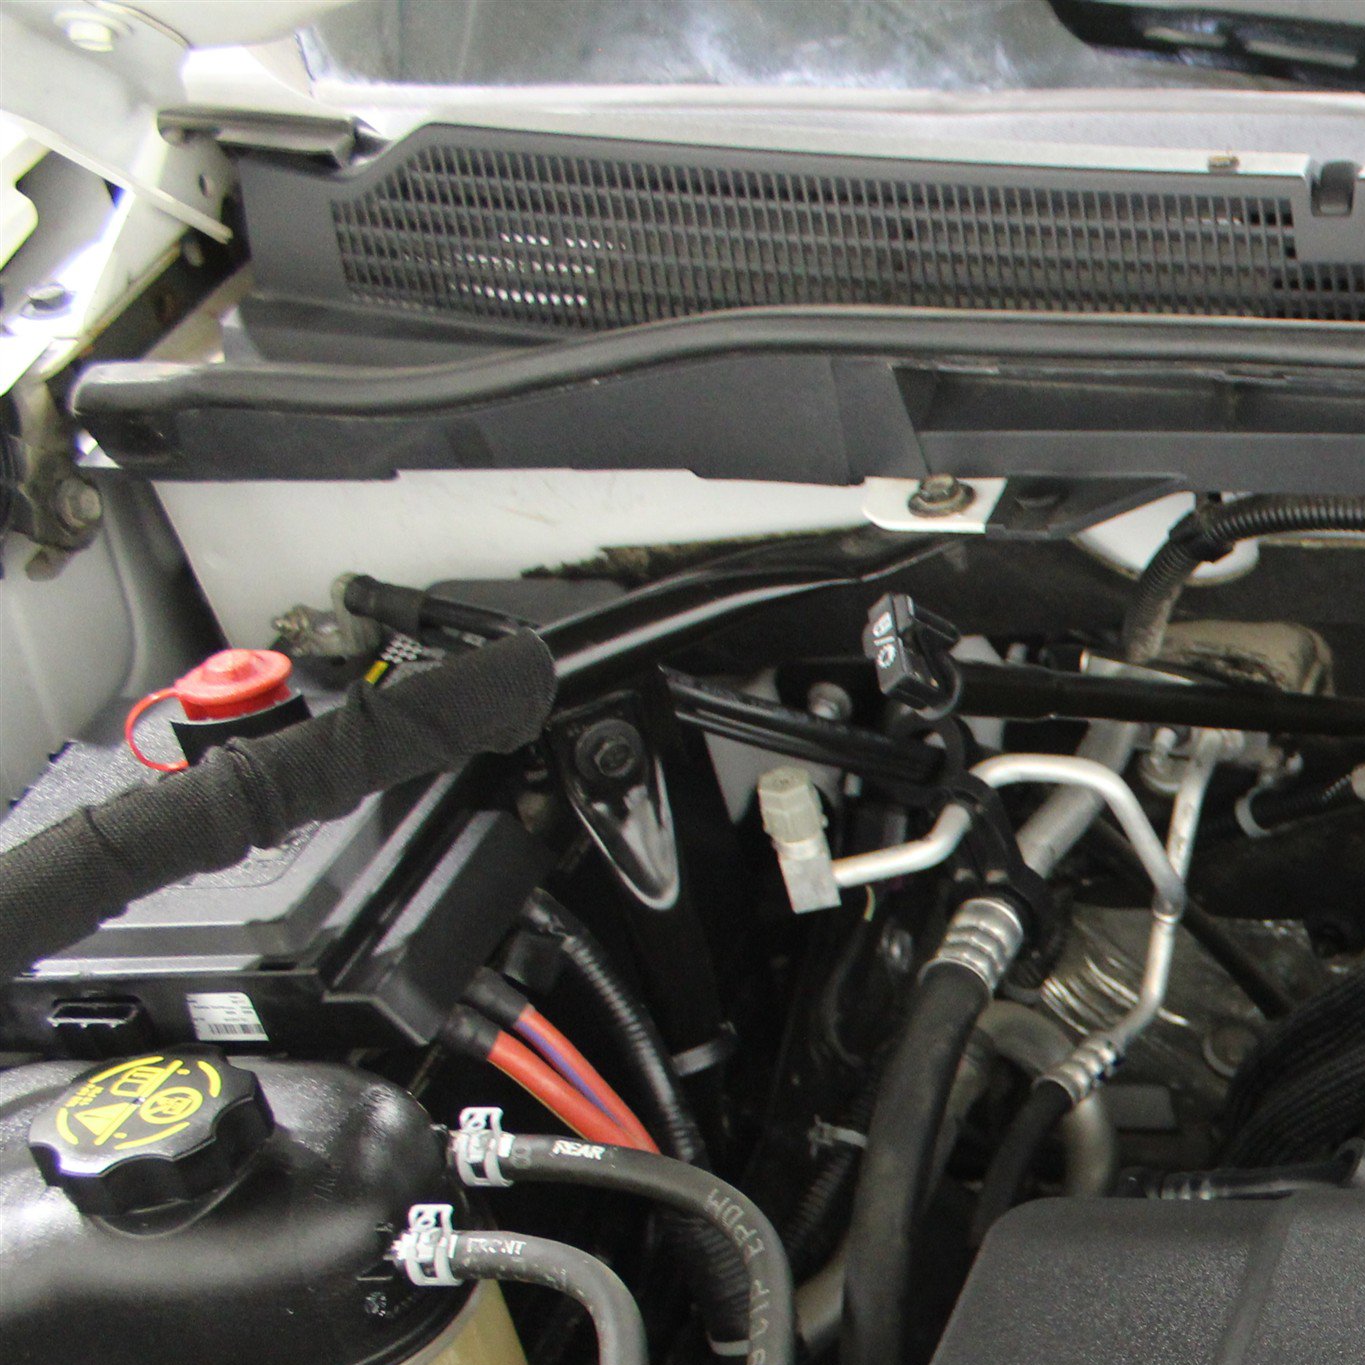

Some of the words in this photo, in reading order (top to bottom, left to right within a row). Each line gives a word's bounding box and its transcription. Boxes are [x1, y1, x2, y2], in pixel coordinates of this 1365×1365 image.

[552, 1140, 606, 1161] REAR
[704, 1188, 766, 1260] EPDM
[466, 1238, 527, 1255] FRONT
